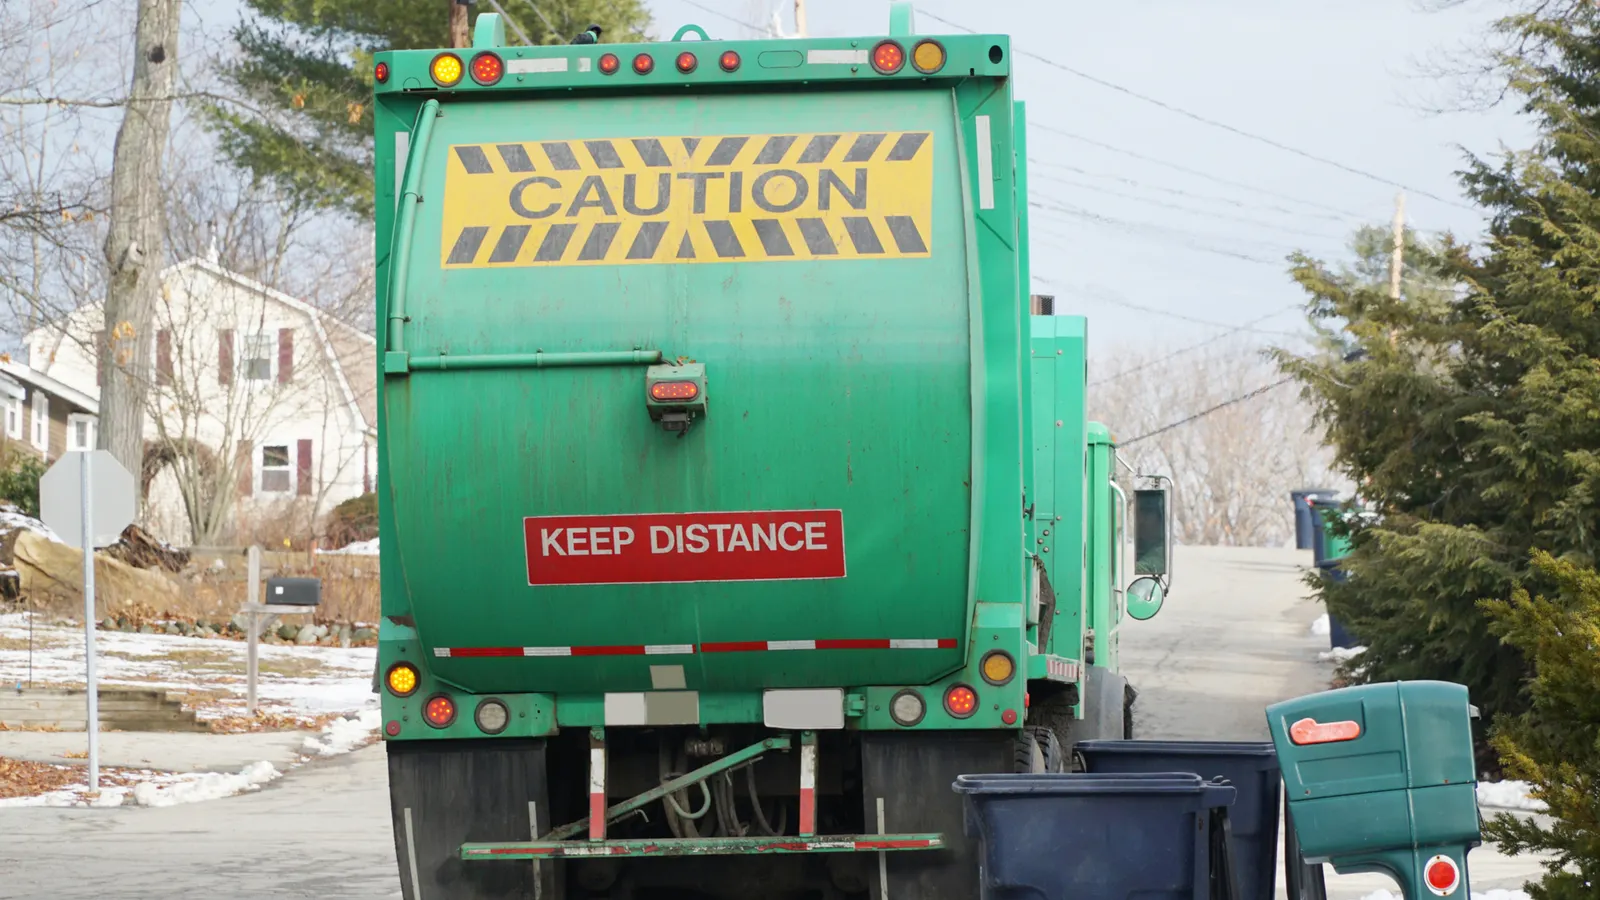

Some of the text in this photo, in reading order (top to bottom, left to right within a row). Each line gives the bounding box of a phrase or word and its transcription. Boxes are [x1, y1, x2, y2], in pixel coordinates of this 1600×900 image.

[508, 168, 868, 219] CAUTION
[541, 521, 828, 556] KEEP DISTANCE
